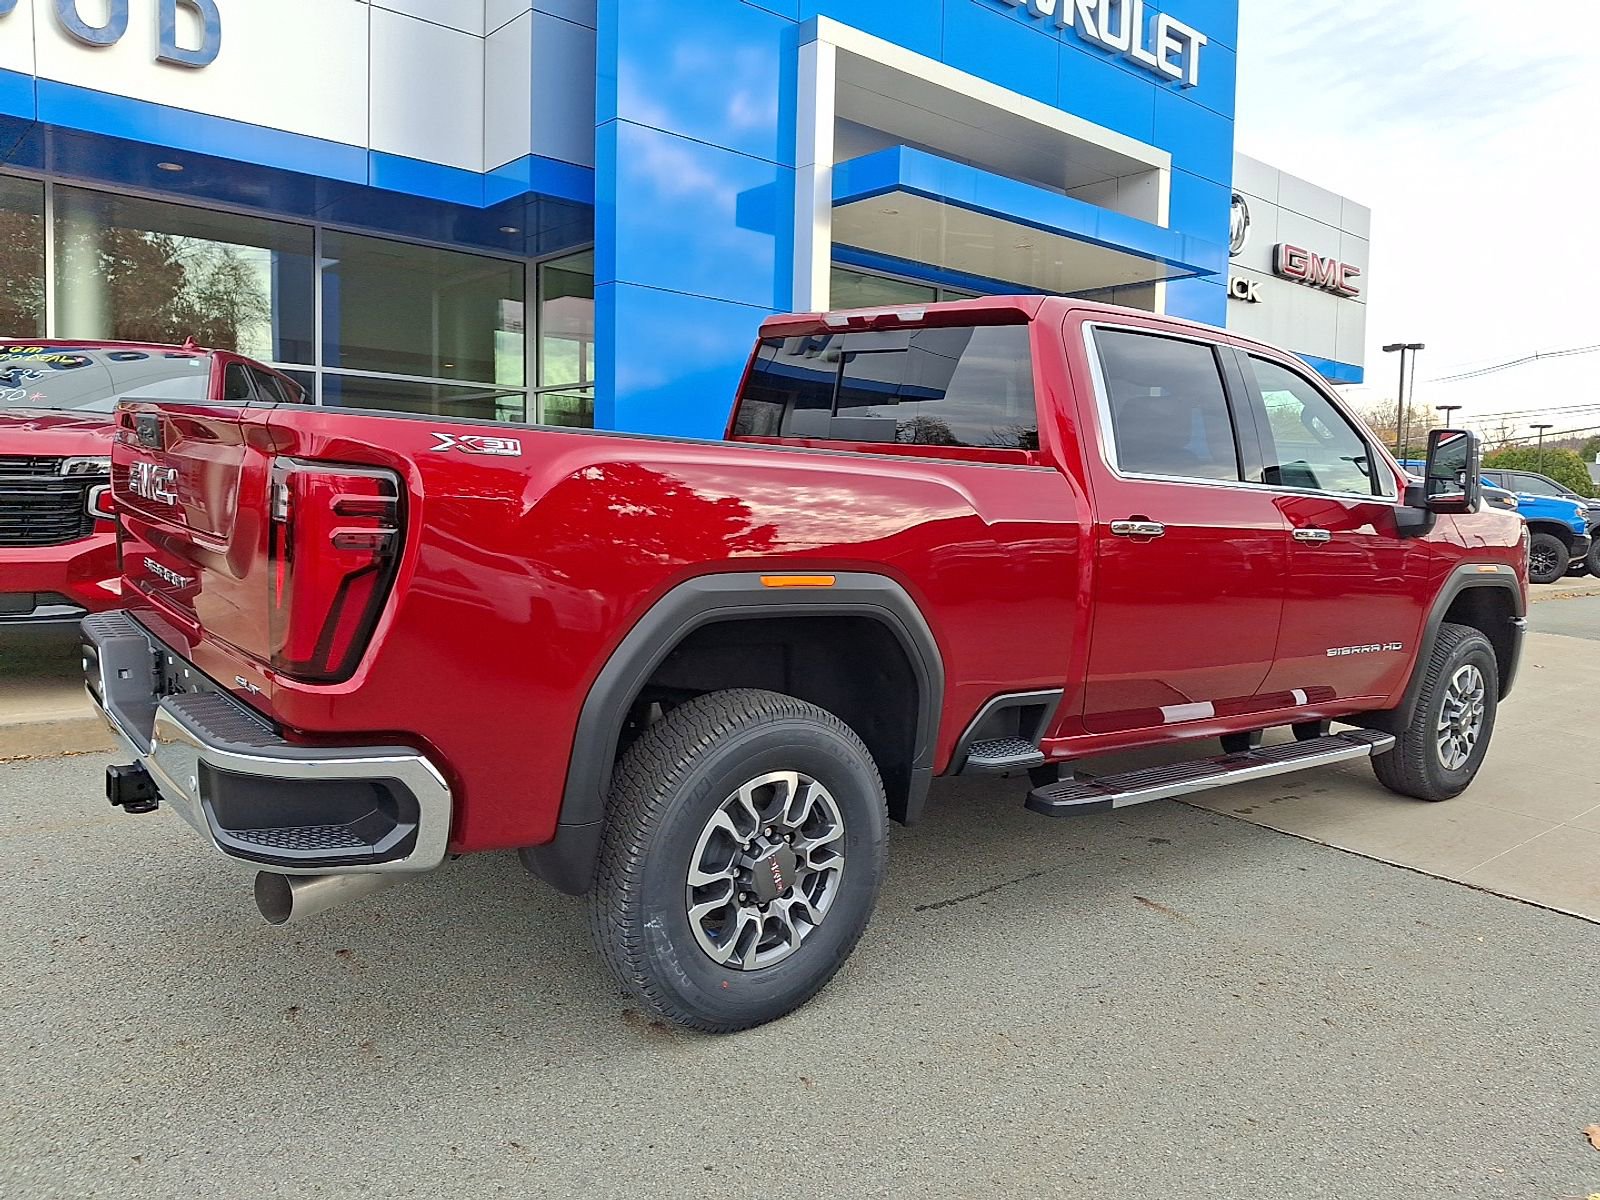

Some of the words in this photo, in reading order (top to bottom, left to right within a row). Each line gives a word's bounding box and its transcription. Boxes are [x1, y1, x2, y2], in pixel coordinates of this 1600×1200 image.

[0, 0, 221, 68] OD
[1006, 0, 1207, 88] ROLET
[1276, 243, 1361, 298] GMC
[129, 461, 178, 506] GMC
[1326, 644, 1380, 657] SIERRA
[1382, 642, 1403, 651] HD
[234, 675, 261, 696] SLT
